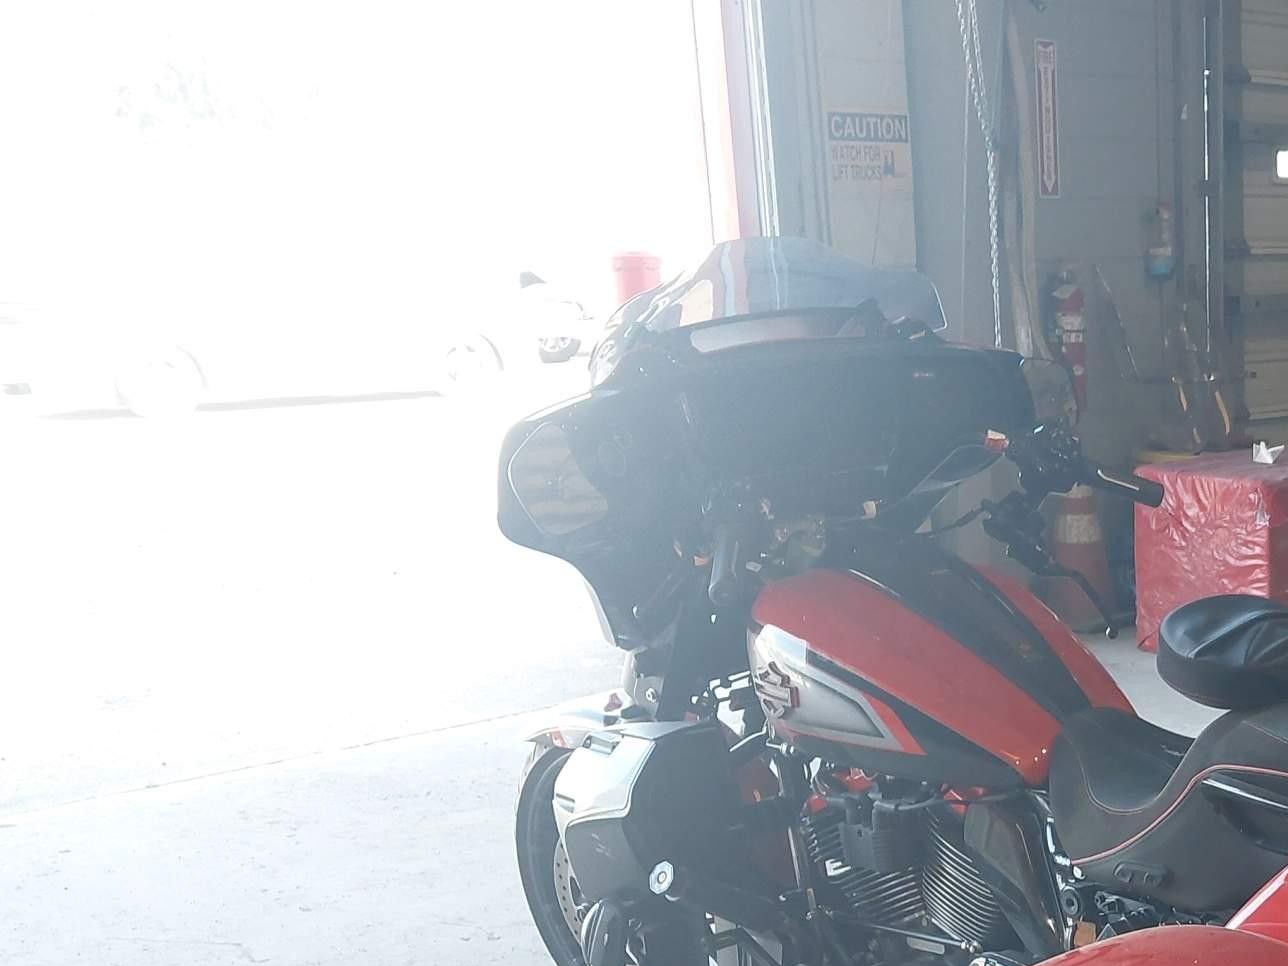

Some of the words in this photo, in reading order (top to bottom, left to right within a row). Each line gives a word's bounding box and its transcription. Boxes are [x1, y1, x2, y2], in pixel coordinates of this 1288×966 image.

[831, 115, 906, 140] CAUTION
[832, 145, 862, 161] WATCH
[864, 145, 881, 161] FOR
